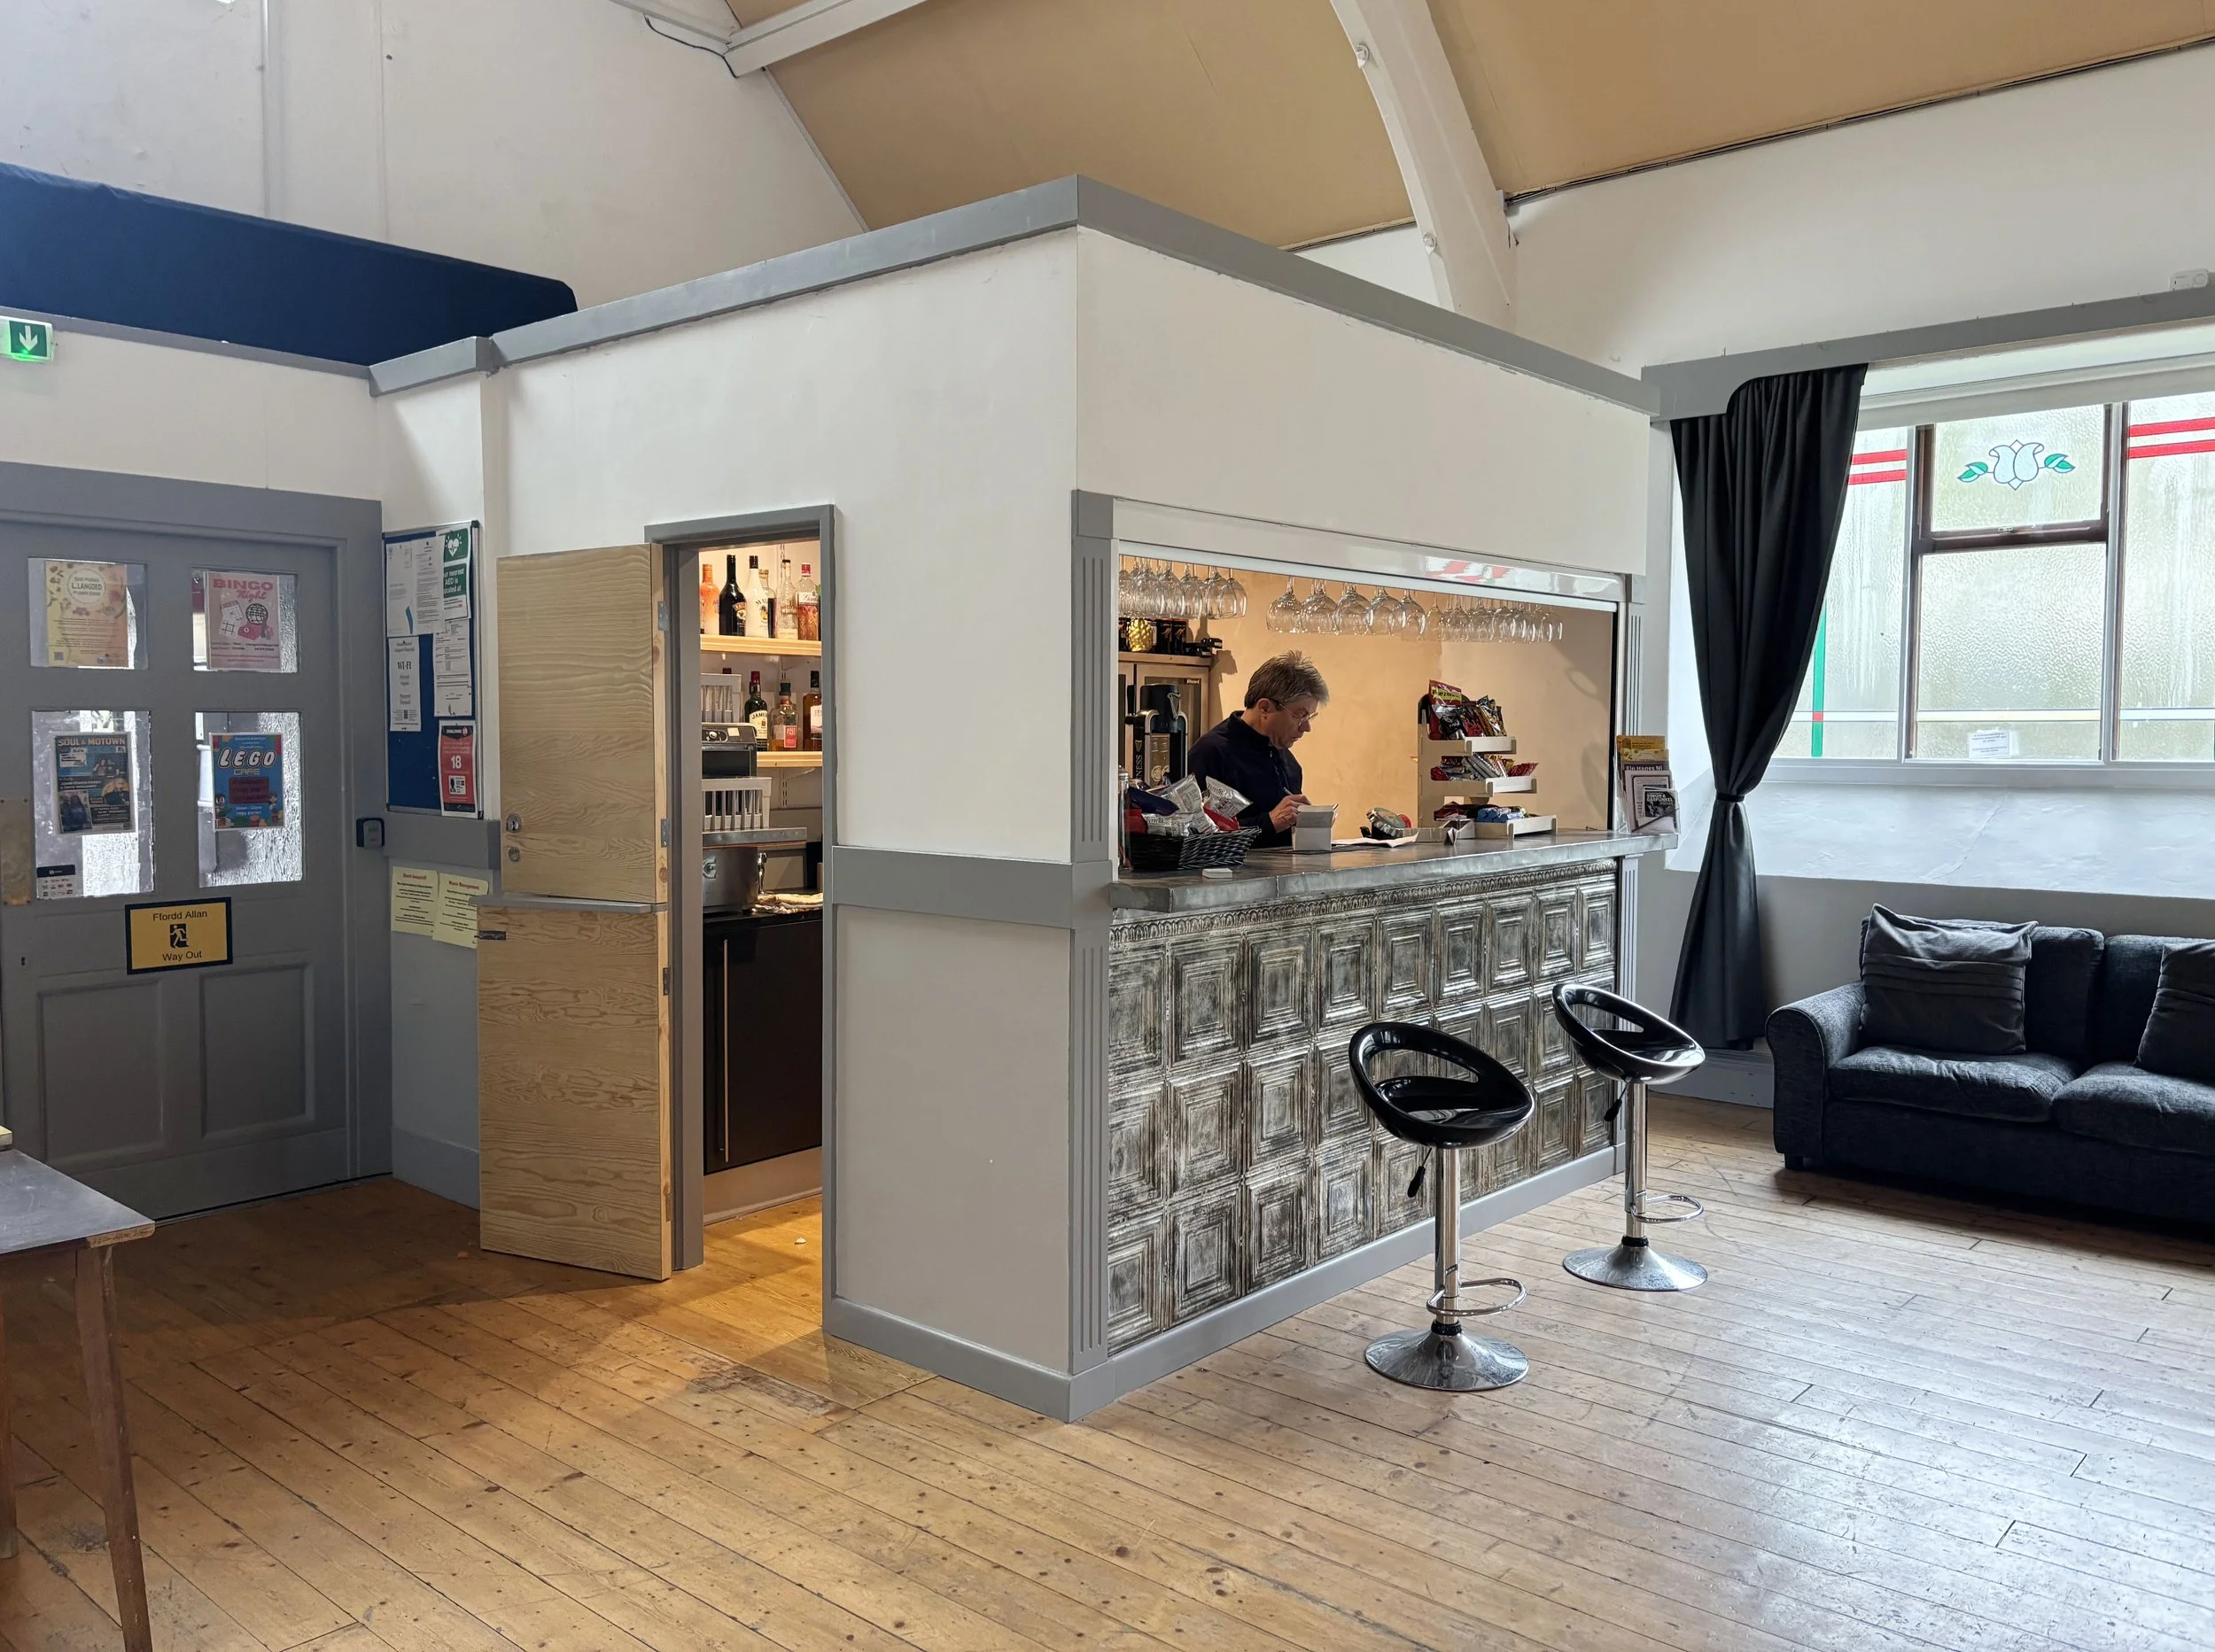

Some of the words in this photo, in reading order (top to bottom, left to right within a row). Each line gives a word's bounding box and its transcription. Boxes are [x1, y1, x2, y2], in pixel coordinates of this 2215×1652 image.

[213, 578, 274, 592] BINGO
[237, 590, 268, 603] Night
[398, 661, 412, 671] WI-FI
[58, 738, 82, 747] SOUL
[88, 737, 126, 746] MOTOWN
[218, 747, 276, 769] LEGO
[451, 755, 462, 769] 18
[152, 911, 183, 921] Ffordd
[184, 911, 208, 919] Allan
[162, 952, 183, 962] Way
[185, 950, 203, 959] Out
